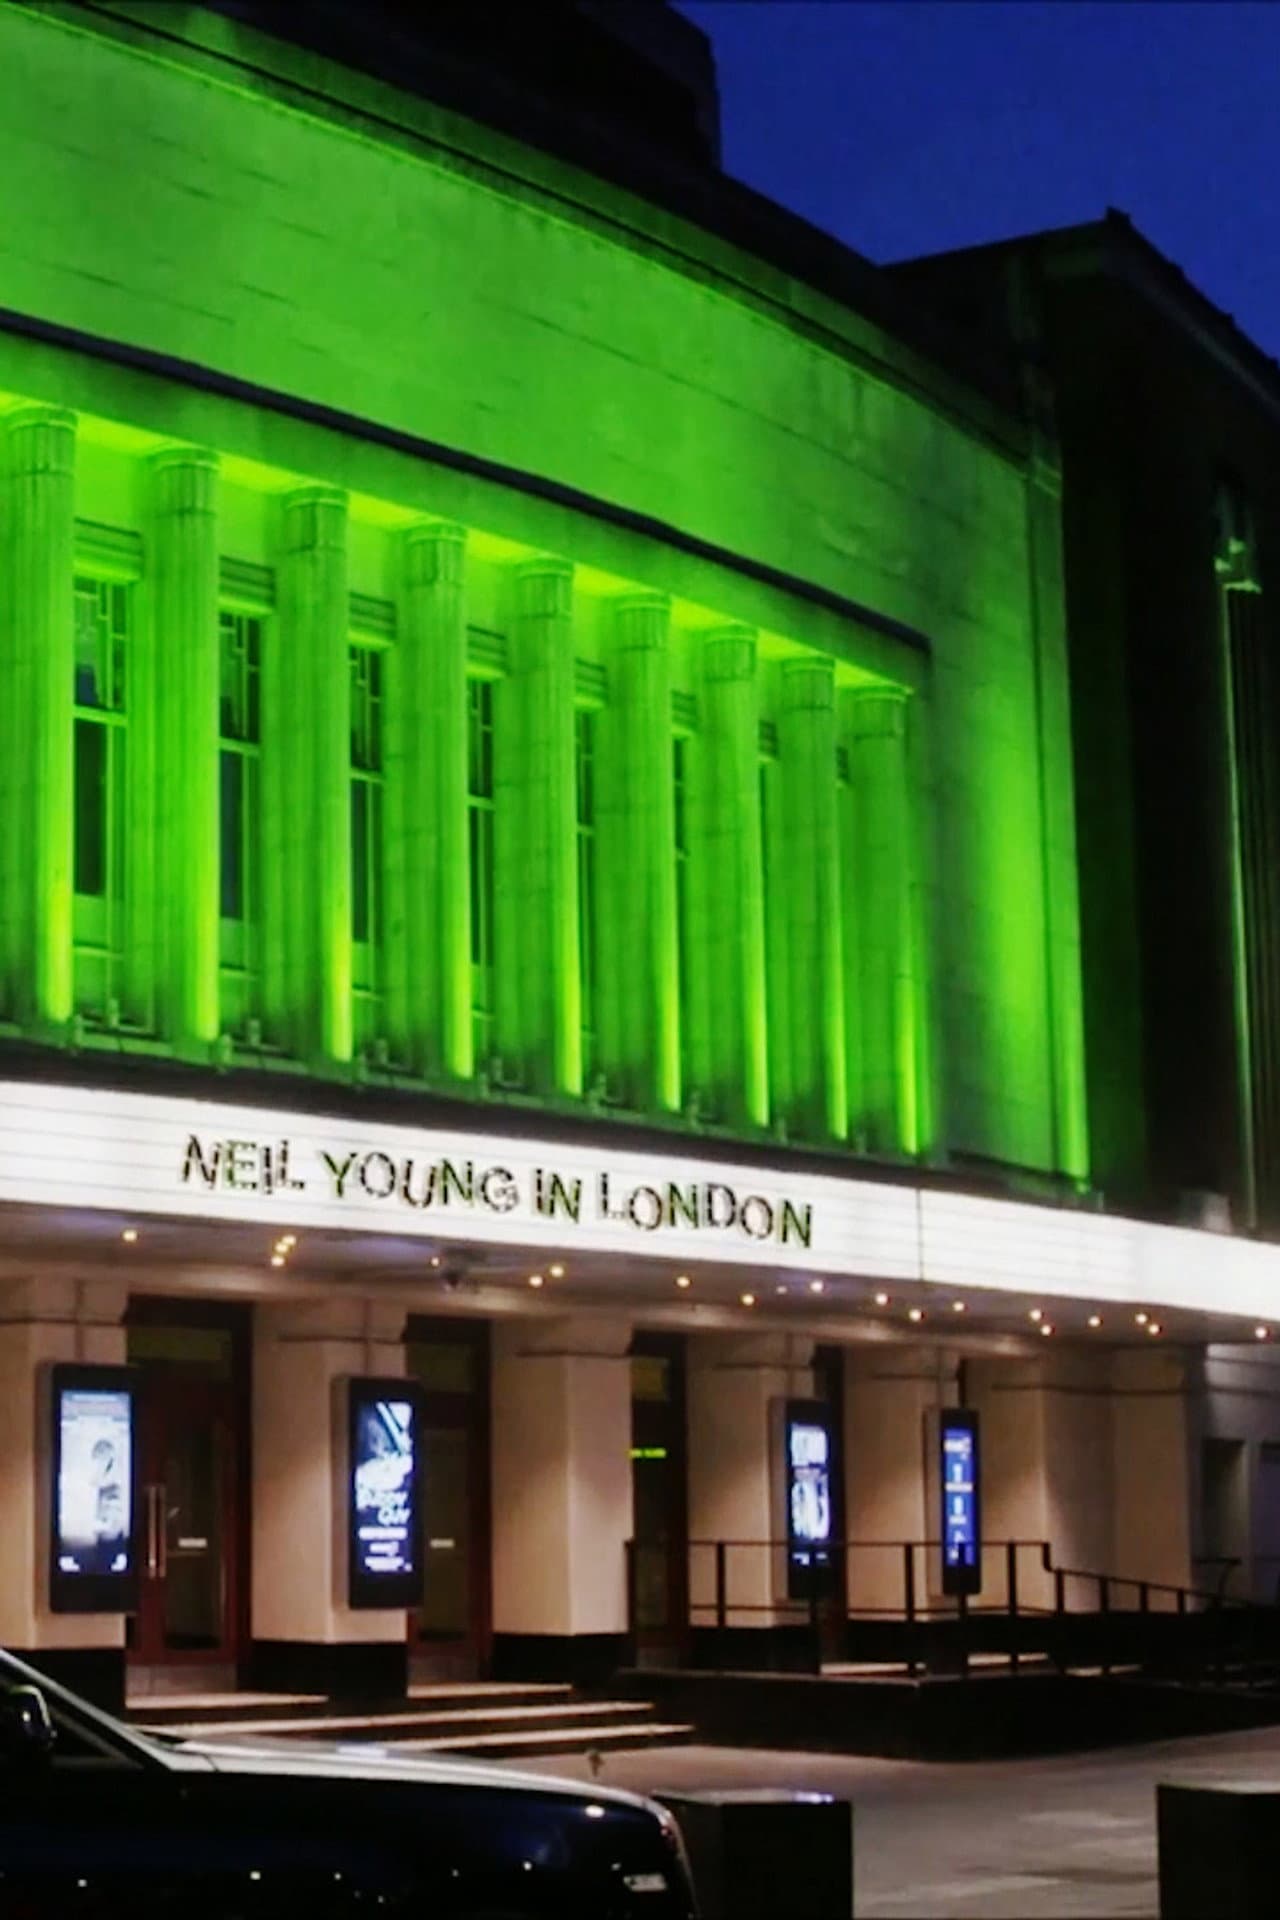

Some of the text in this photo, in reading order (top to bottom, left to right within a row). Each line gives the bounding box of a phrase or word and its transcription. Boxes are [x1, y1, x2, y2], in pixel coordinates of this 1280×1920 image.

[182, 1135, 813, 1248] NEIL YOUNG IN LONDON
